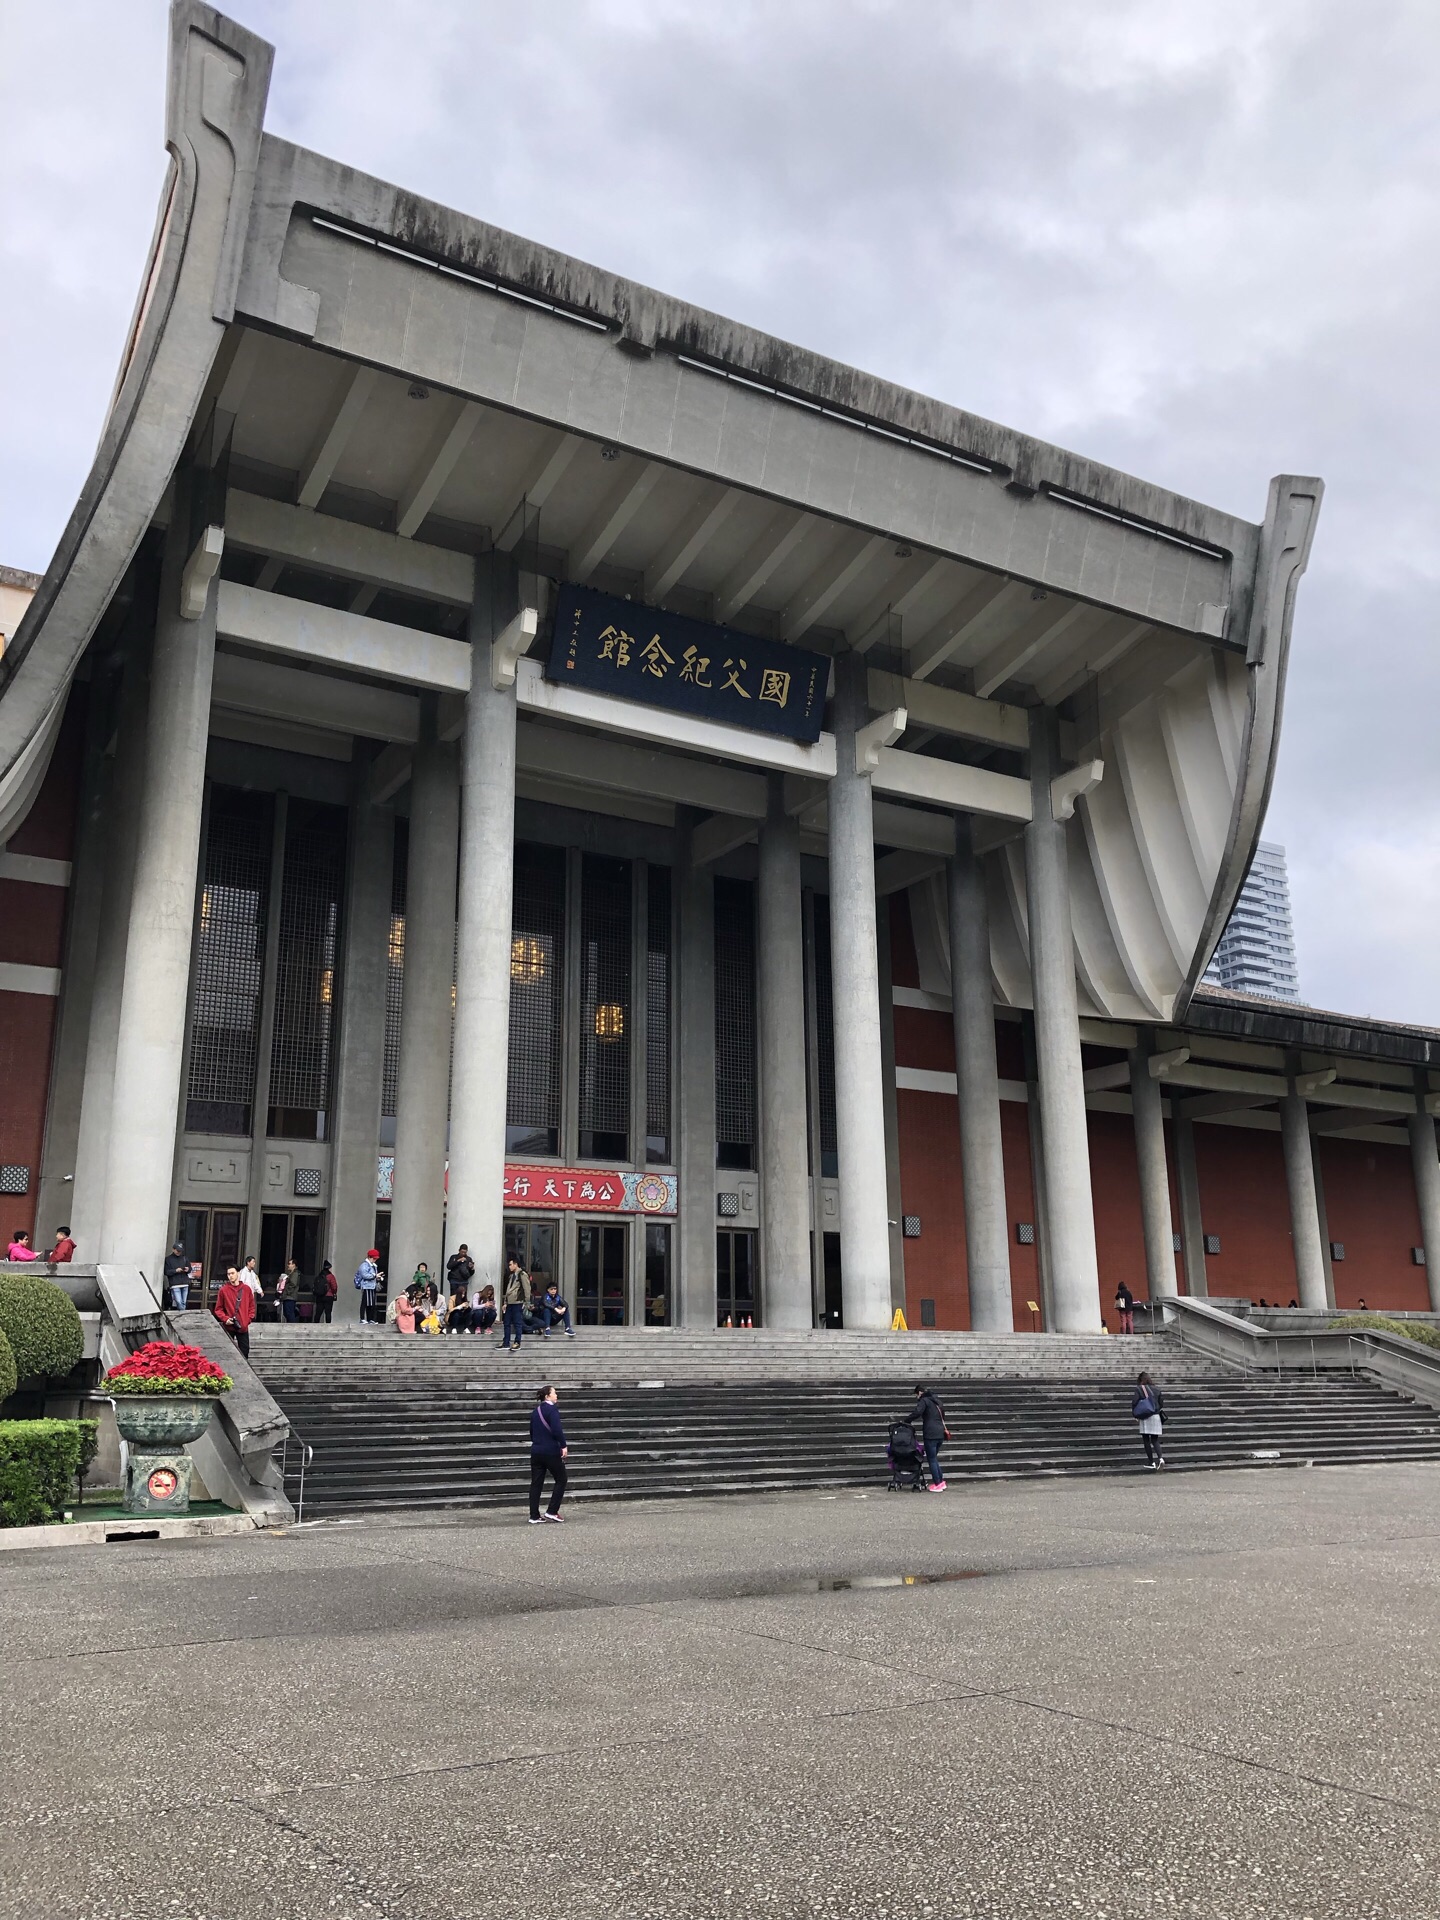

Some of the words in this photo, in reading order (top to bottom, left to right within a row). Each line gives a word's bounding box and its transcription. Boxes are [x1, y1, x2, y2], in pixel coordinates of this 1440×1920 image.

[597, 624, 791, 709] 國父紀念館
[543, 1178, 615, 1201] 天下為公
